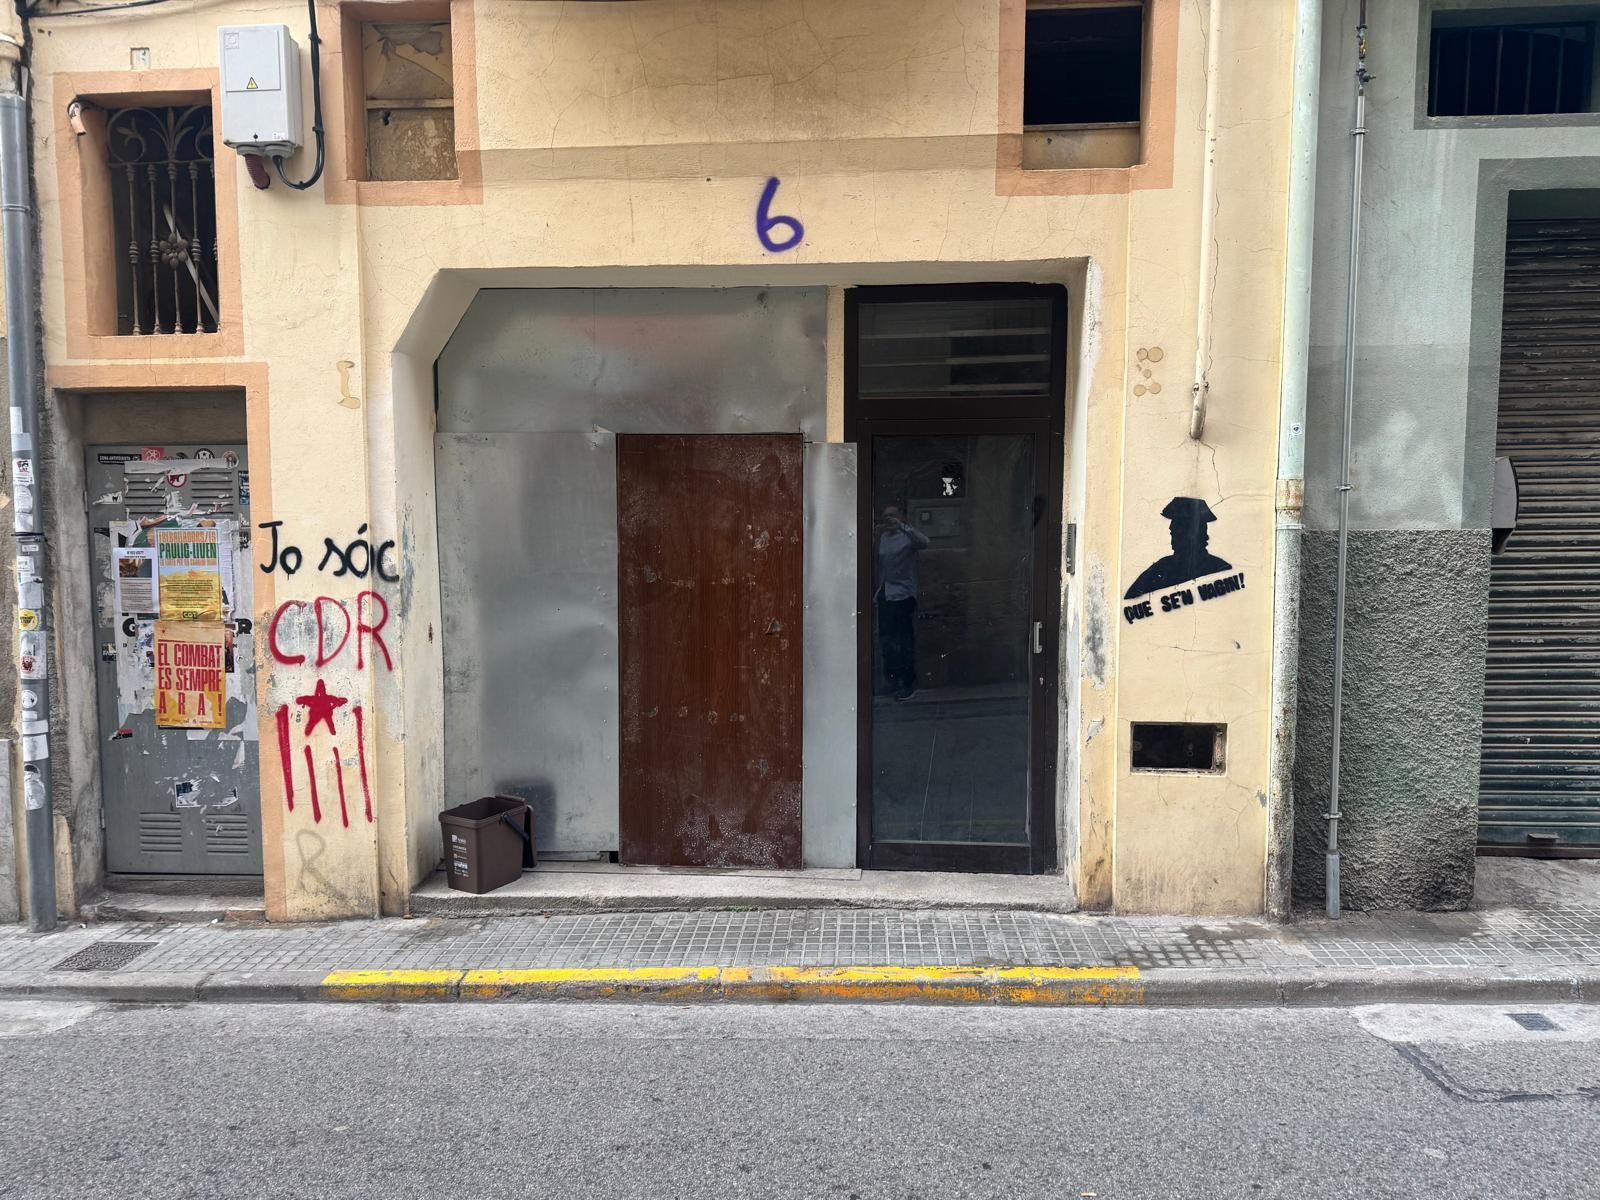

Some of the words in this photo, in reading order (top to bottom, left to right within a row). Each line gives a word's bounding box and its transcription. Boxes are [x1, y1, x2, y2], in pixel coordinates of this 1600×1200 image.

[756, 176, 805, 253] 6
[258, 520, 303, 576] Jo
[318, 523, 400, 582] sóc
[1123, 601, 1154, 624] QUE
[1160, 589, 1194, 612] SE'N
[1198, 572, 1246, 601] VAGIN!
[158, 643, 170, 666] EL
[174, 643, 222, 668] COMBAT
[268, 590, 393, 672] CDR
[158, 667, 172, 690] ES
[176, 667, 222, 692] SEMPRE
